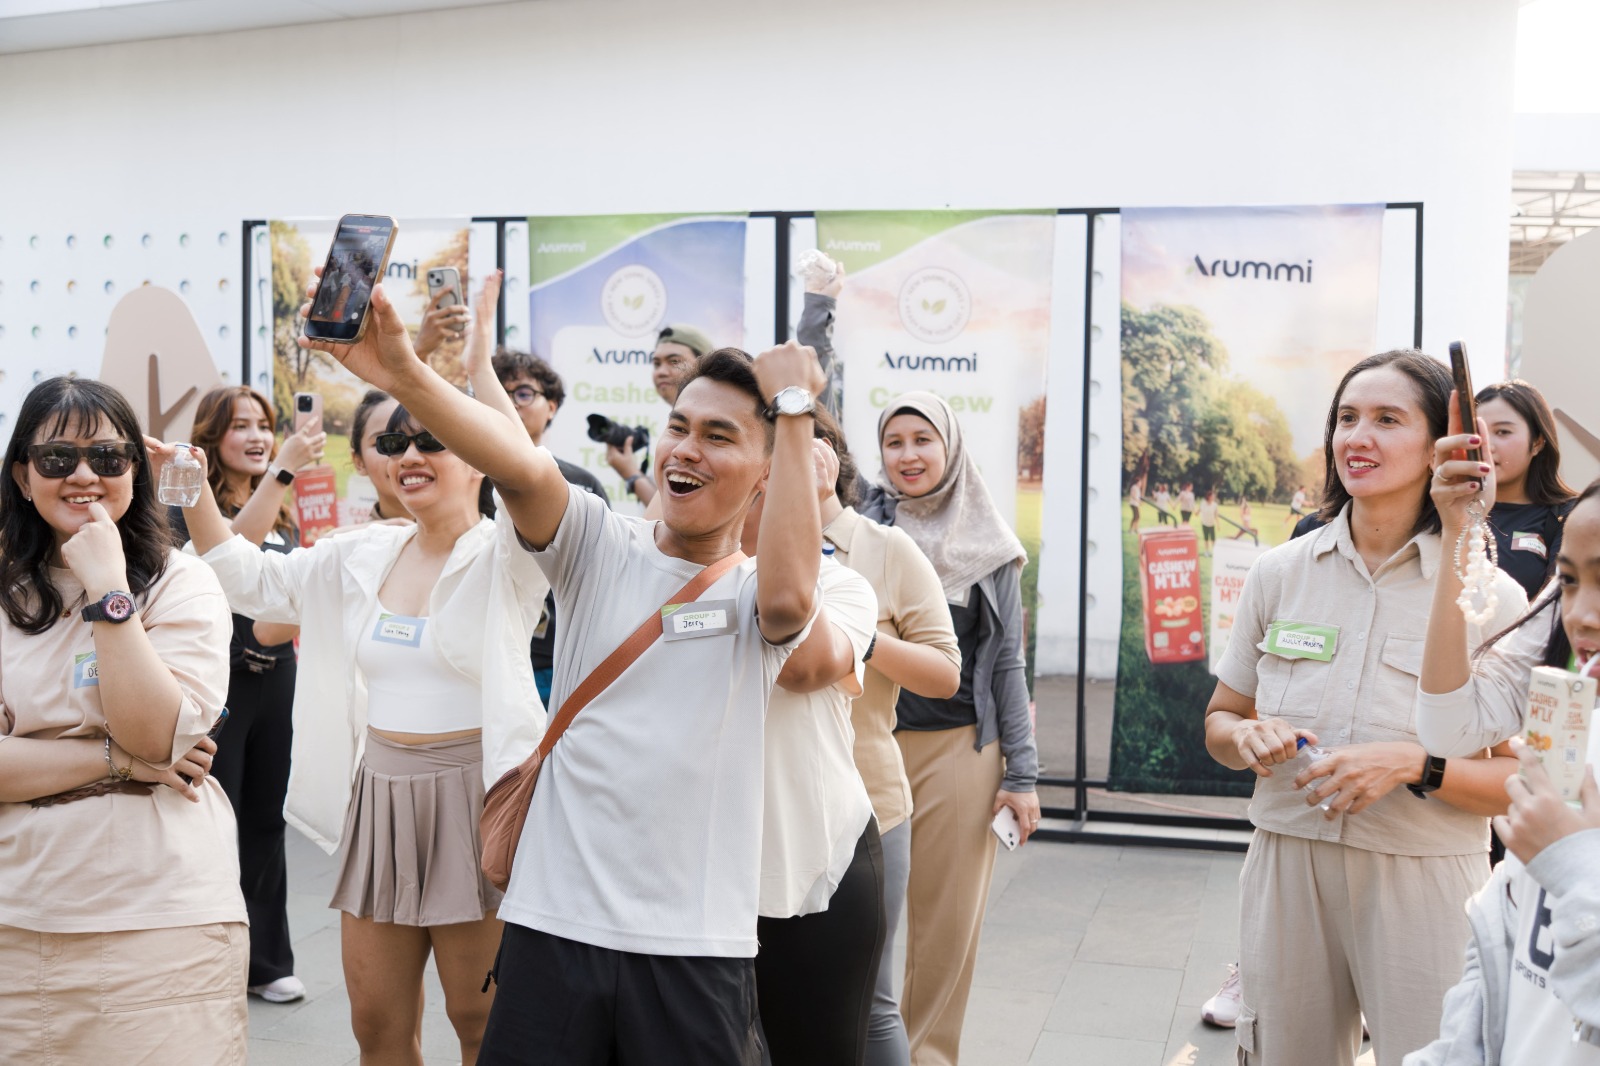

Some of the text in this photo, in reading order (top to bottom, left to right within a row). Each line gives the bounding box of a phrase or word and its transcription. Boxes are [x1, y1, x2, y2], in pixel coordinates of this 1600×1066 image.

[1185, 254, 1312, 283] Arummi
[587, 348, 656, 364] Arum
[879, 352, 977, 371] Arummi
[573, 382, 660, 404] Cashe
[1149, 559, 1196, 575] CASHEW
[1215, 576, 1245, 588] CASH
[1286, 632, 1310, 641] GROUP
[1514, 959, 1547, 990] SPORTS
